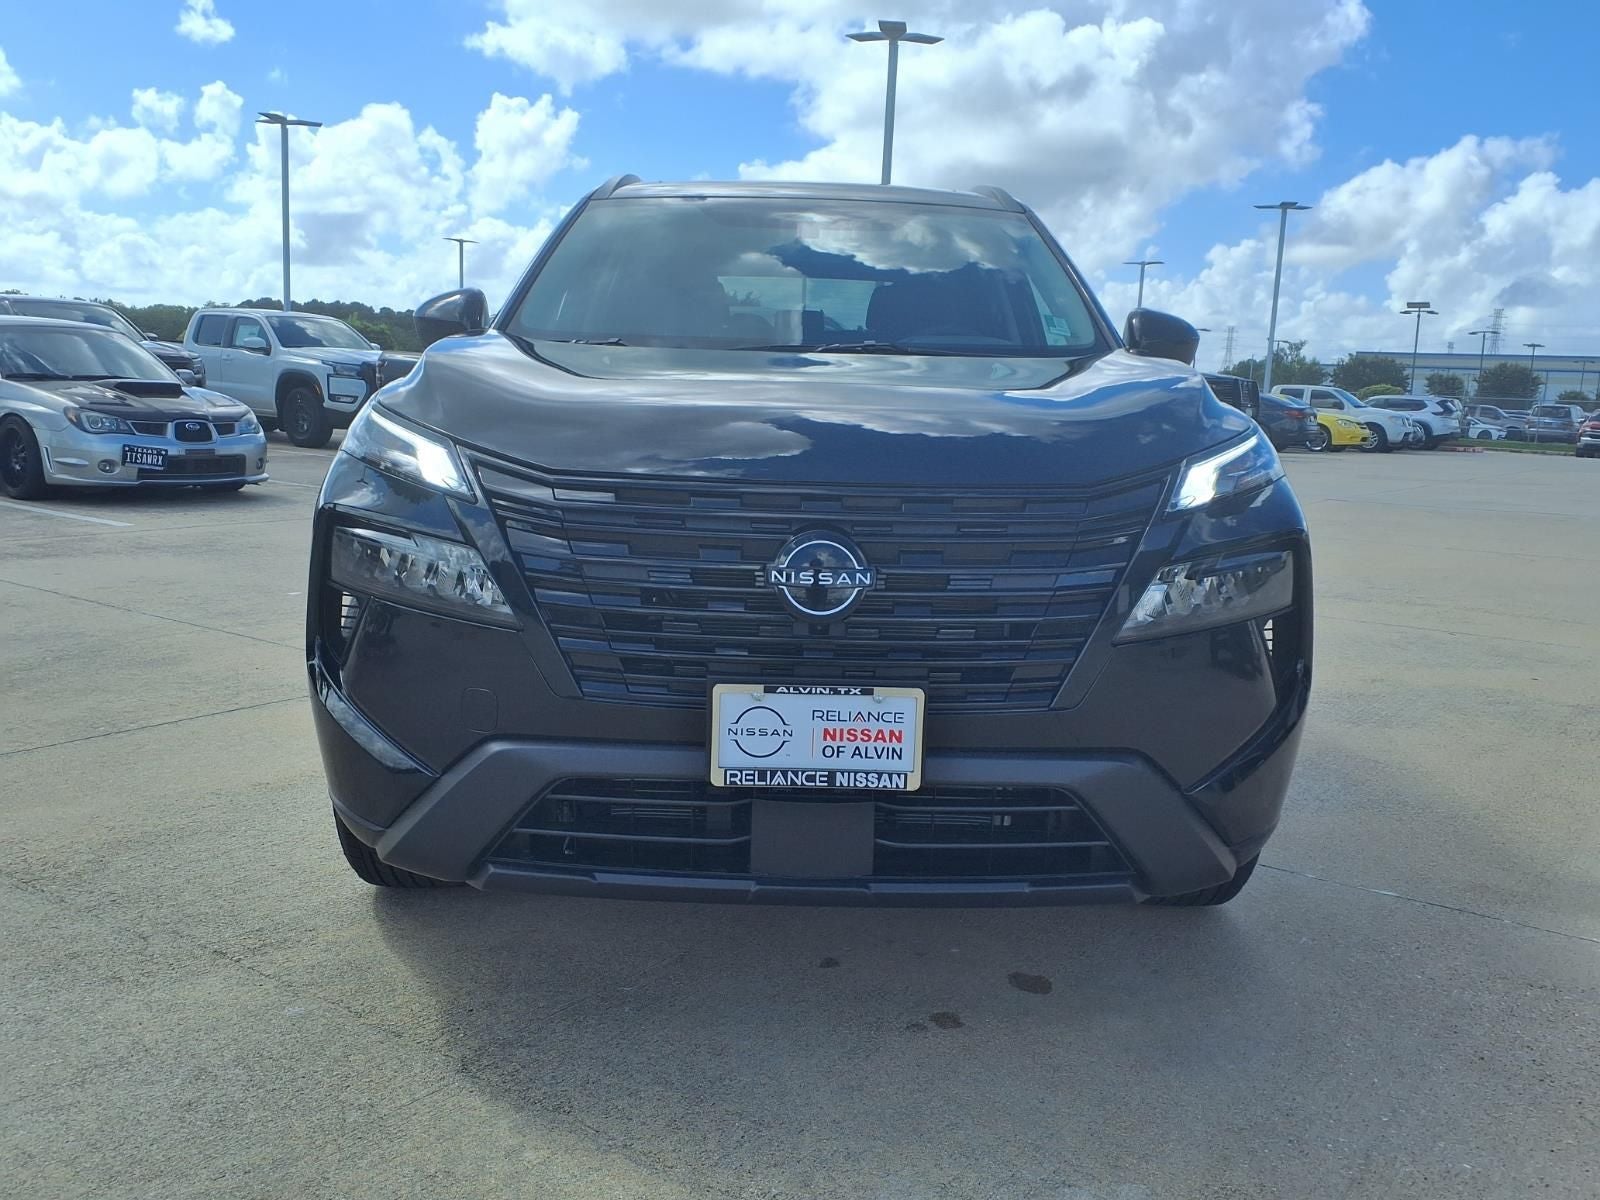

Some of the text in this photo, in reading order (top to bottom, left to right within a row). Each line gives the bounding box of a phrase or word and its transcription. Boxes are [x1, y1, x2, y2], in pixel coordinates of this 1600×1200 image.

[126, 452, 163, 465] ITSAWRX
[771, 570, 871, 585] NISSAN
[776, 686, 862, 695] ALVIN, TX
[812, 709, 904, 724] RELIANCE
[727, 727, 793, 738] NISSAN
[822, 727, 903, 744] NISSAN
[821, 745, 903, 761] OF ALVIN
[726, 770, 905, 789] RELIANCE NISSAN
